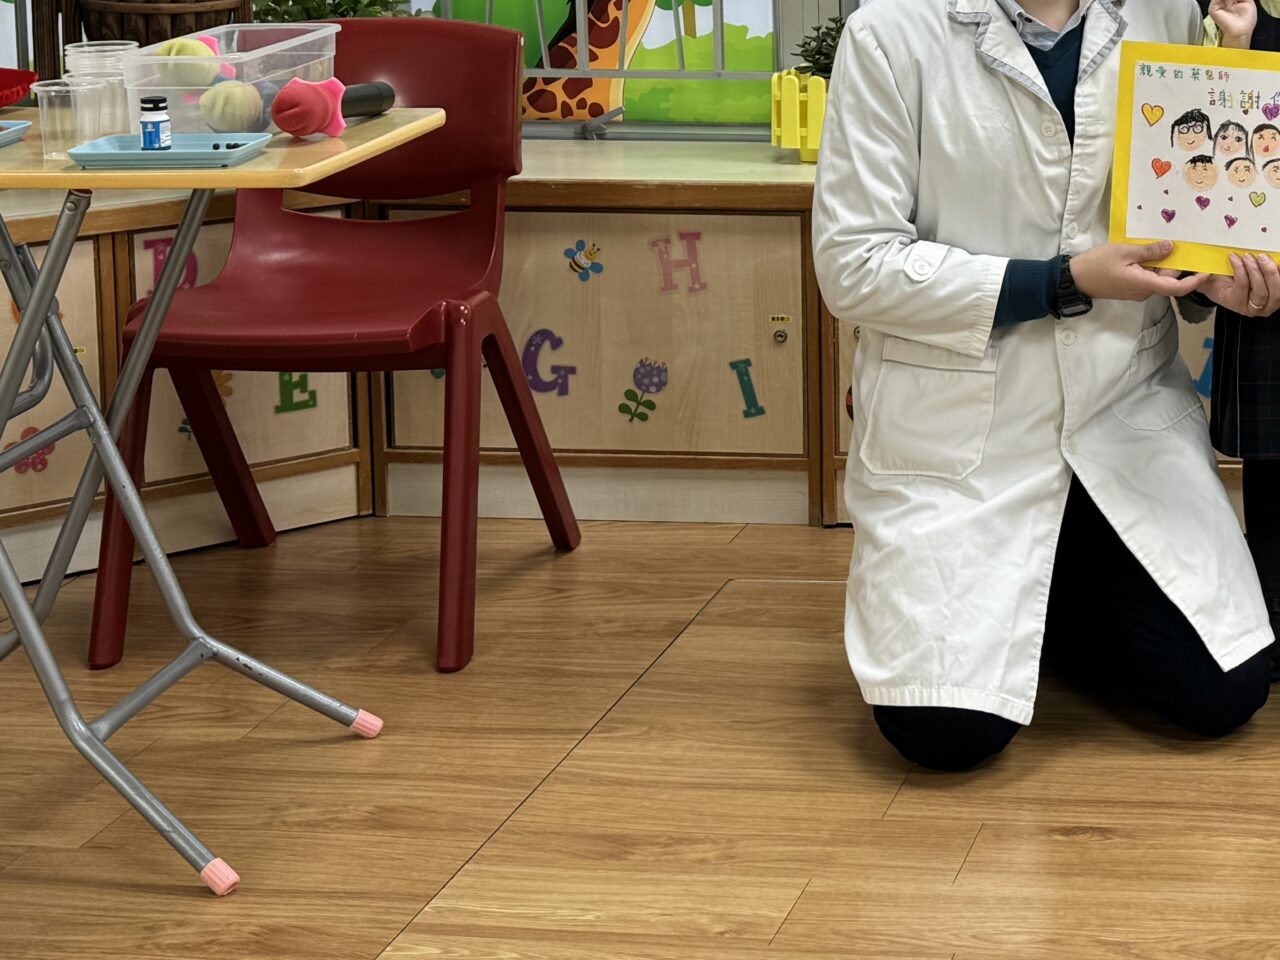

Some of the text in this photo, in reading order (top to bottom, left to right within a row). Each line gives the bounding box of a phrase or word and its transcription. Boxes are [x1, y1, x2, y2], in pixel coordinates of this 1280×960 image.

[648, 232, 707, 294] H
[275, 371, 317, 413] E
[522, 329, 576, 396] G
[729, 358, 765, 419] I
